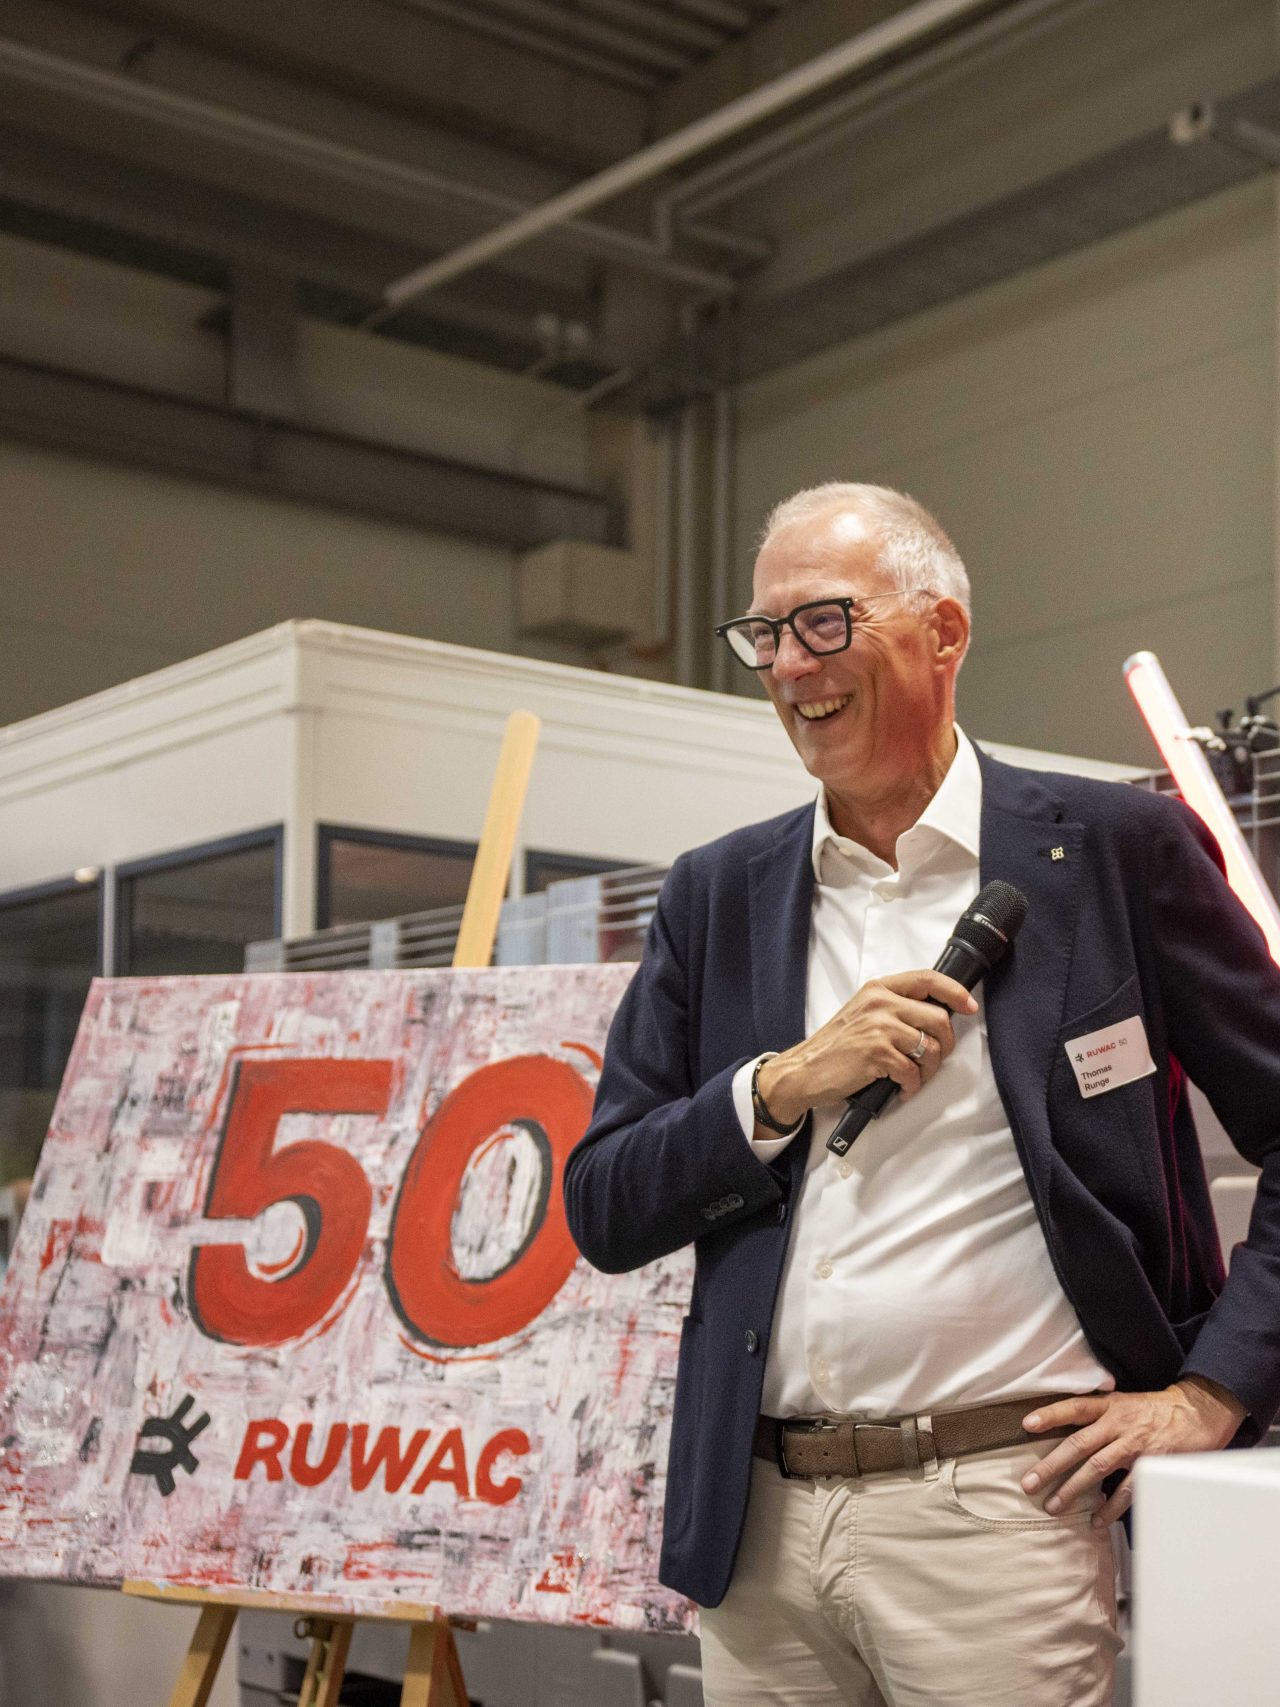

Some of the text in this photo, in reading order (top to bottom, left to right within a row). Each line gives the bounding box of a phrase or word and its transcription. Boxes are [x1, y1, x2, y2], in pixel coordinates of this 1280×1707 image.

[1086, 1038, 1128, 1058] RUWAC 50
[1081, 1064, 1112, 1080] Thomas
[1084, 1077, 1110, 1091] Runge
[188, 1055, 600, 1347] 50
[234, 1418, 531, 1505] RUWAC
